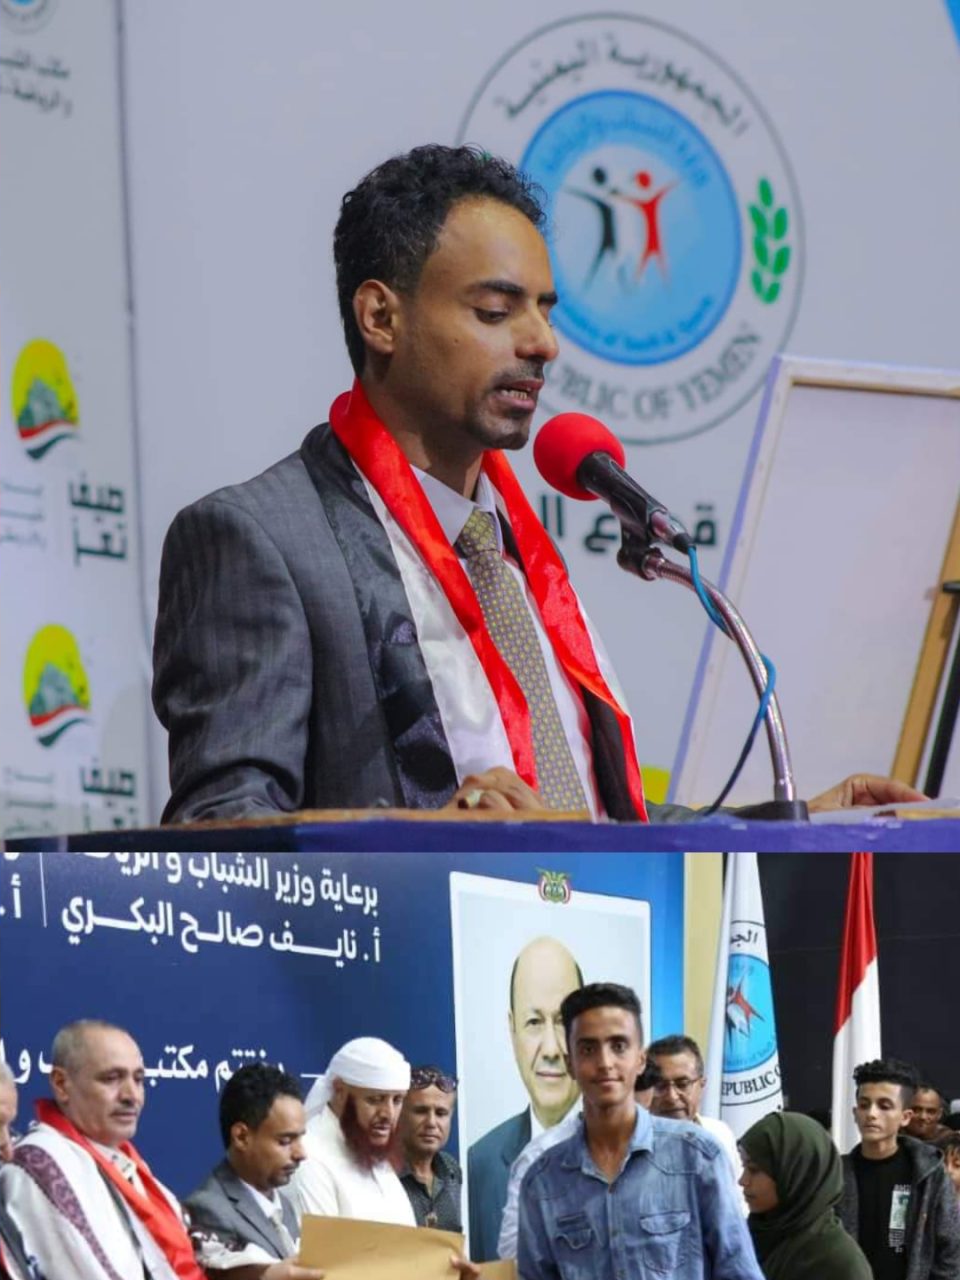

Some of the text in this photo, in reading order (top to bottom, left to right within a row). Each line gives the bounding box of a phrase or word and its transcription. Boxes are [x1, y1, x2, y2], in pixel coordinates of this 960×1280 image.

[188, 852, 270, 894] الشباب
[275, 863, 316, 907] وزير
[319, 868, 379, 918] برعاية
[61, 895, 174, 946] البكري
[179, 908, 264, 954] صالح
[268, 920, 358, 968] نايف
